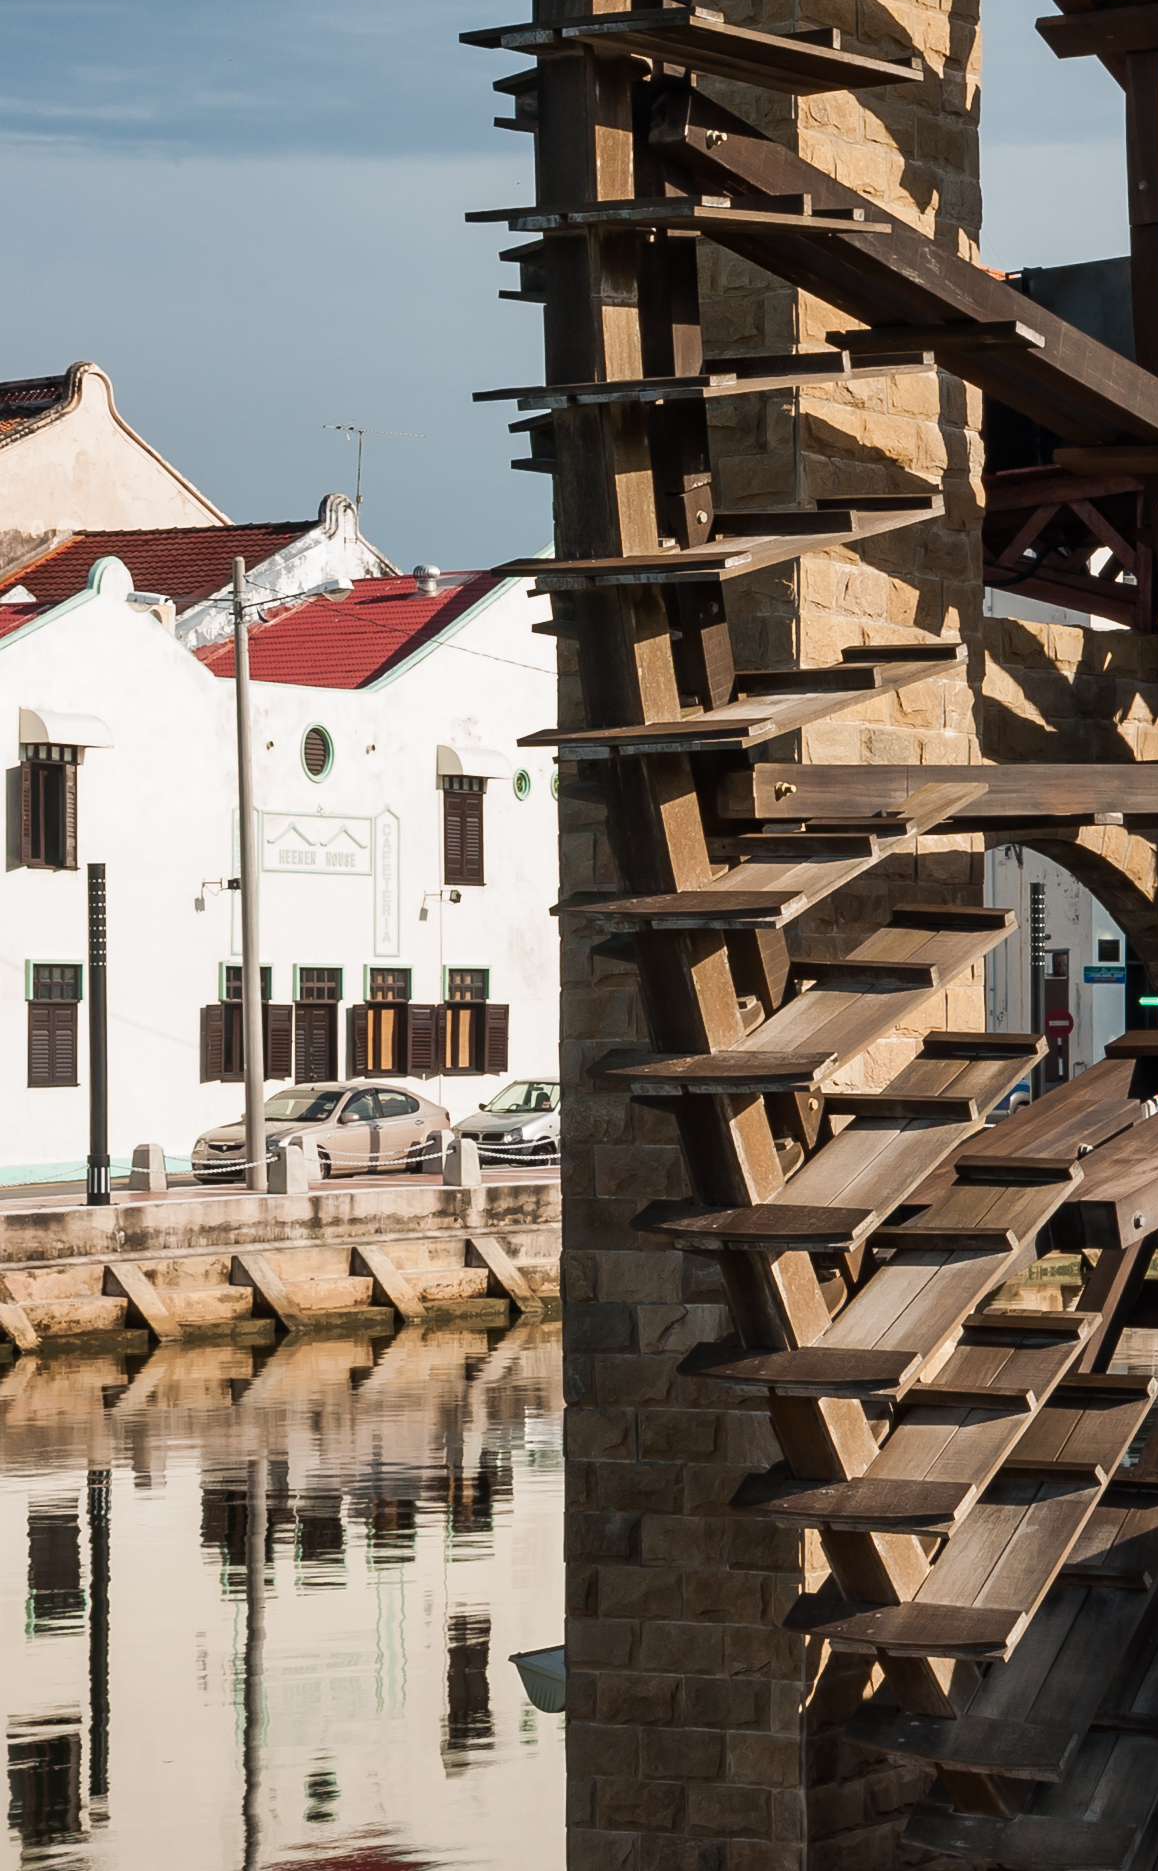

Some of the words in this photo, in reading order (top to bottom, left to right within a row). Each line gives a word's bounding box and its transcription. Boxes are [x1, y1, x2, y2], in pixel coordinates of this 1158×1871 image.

[278, 848, 317, 866] HEEREN
[325, 850, 357, 868] HOUSE
[381, 823, 392, 944] CAFETERIA
